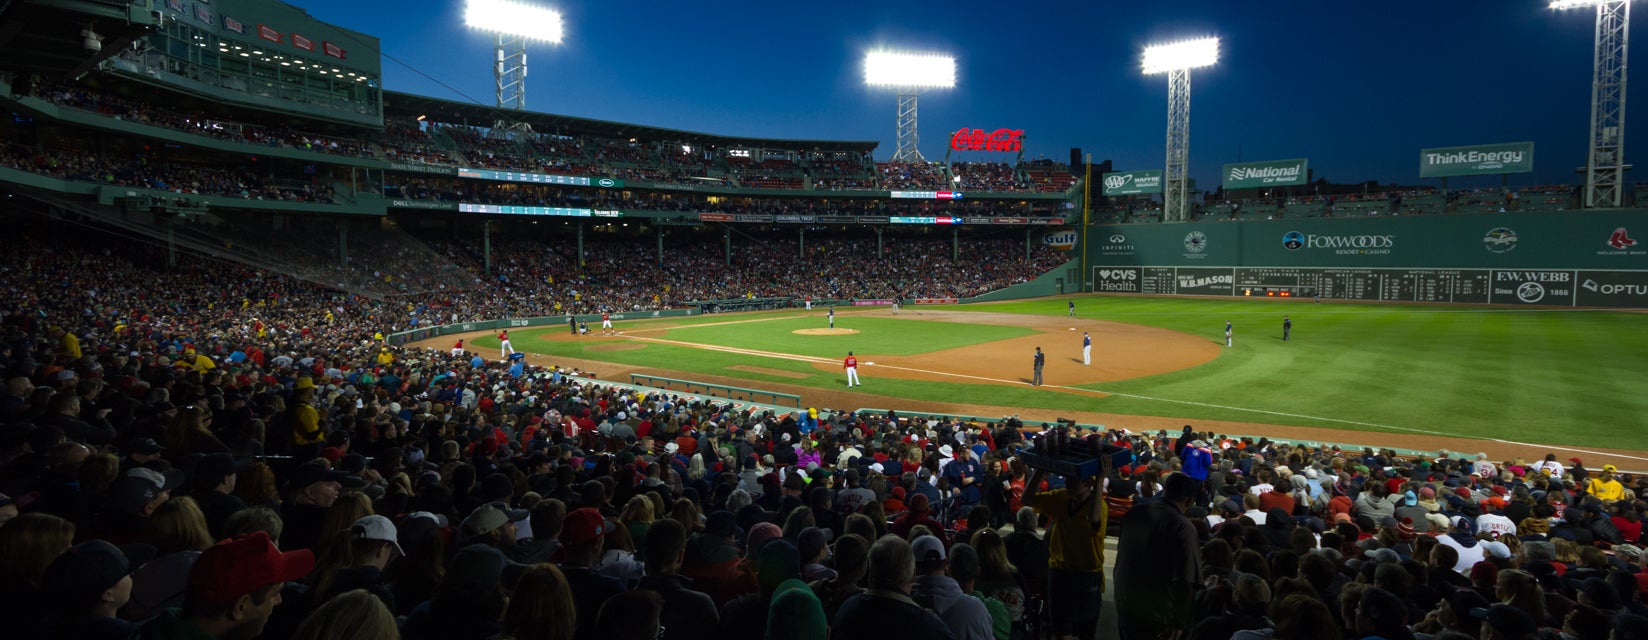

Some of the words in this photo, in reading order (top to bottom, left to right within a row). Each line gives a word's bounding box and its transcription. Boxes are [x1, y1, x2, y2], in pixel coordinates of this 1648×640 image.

[1426, 151, 1523, 165] ThinkEnergy
[1244, 164, 1301, 179] National
[1044, 233, 1076, 244] Gulf
[1307, 235, 1393, 248] FOXWOODS
[1111, 269, 1137, 280] CVS
[1497, 272, 1523, 281] F.W.
[1525, 272, 1570, 282] WEBB
[1100, 280, 1137, 291] Health
[1491, 523, 1510, 532] ORTIZ
